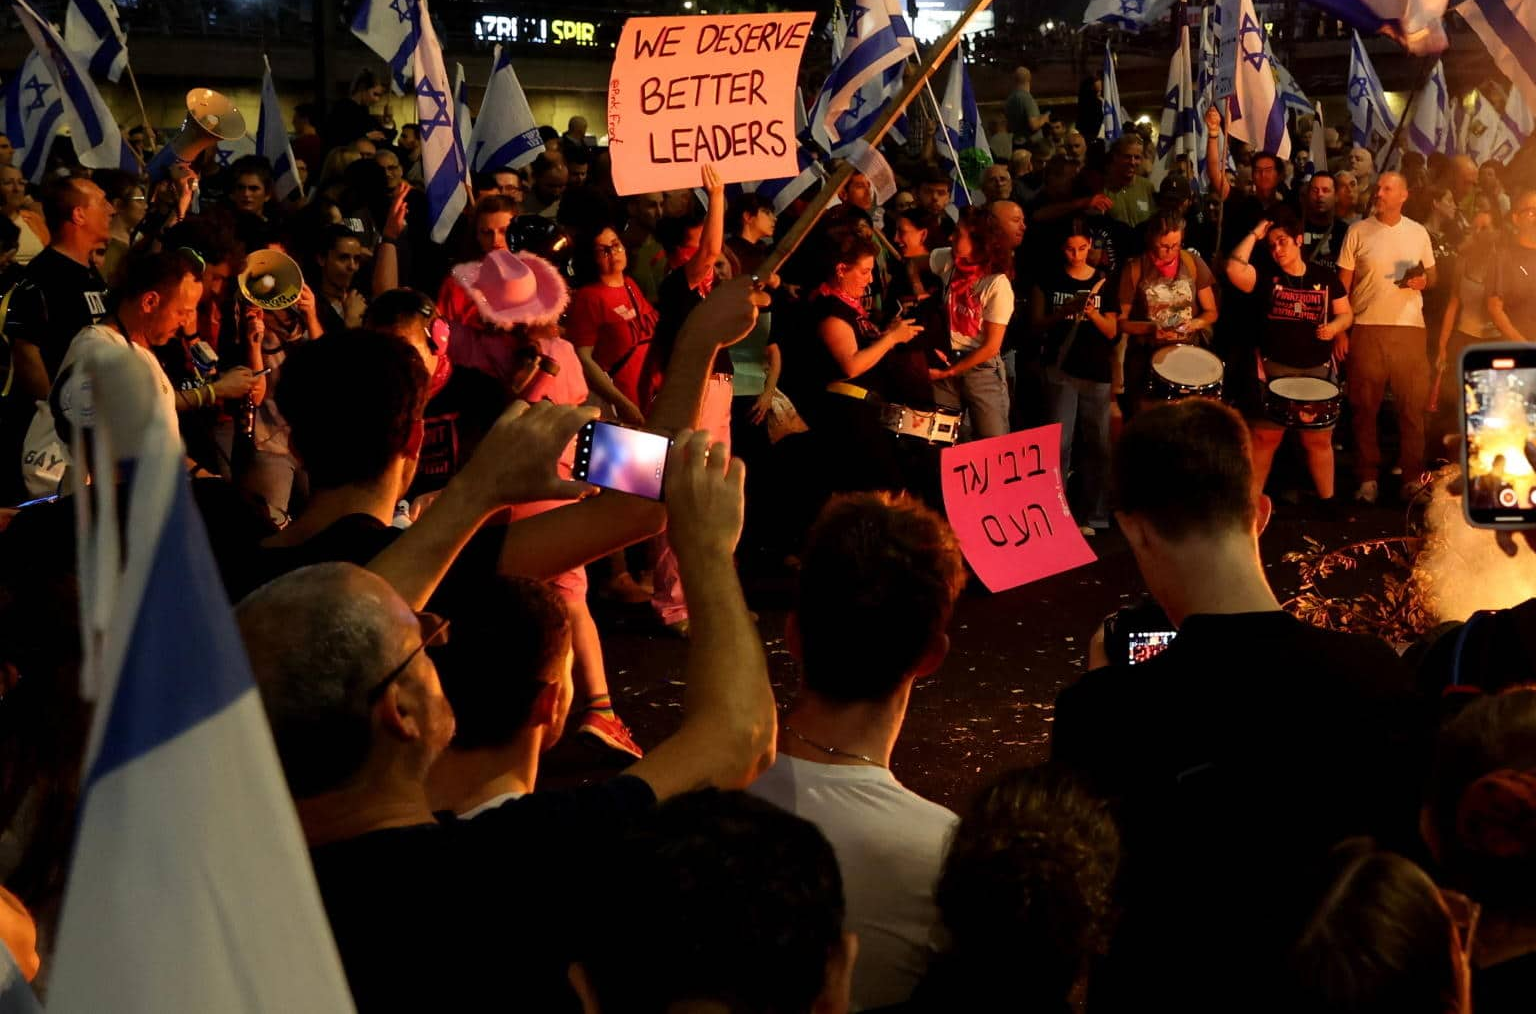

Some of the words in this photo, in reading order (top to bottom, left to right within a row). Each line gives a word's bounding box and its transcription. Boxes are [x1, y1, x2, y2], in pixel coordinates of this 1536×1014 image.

[475, 15, 547, 43] ZRII
[634, 26, 685, 60] WE
[696, 22, 811, 55] DESERVE
[641, 69, 768, 115] BETTER
[650, 120, 787, 164] LEADERS
[953, 458, 988, 495] נגד
[998, 444, 1047, 485] ביבי
[981, 504, 1054, 547] העם
